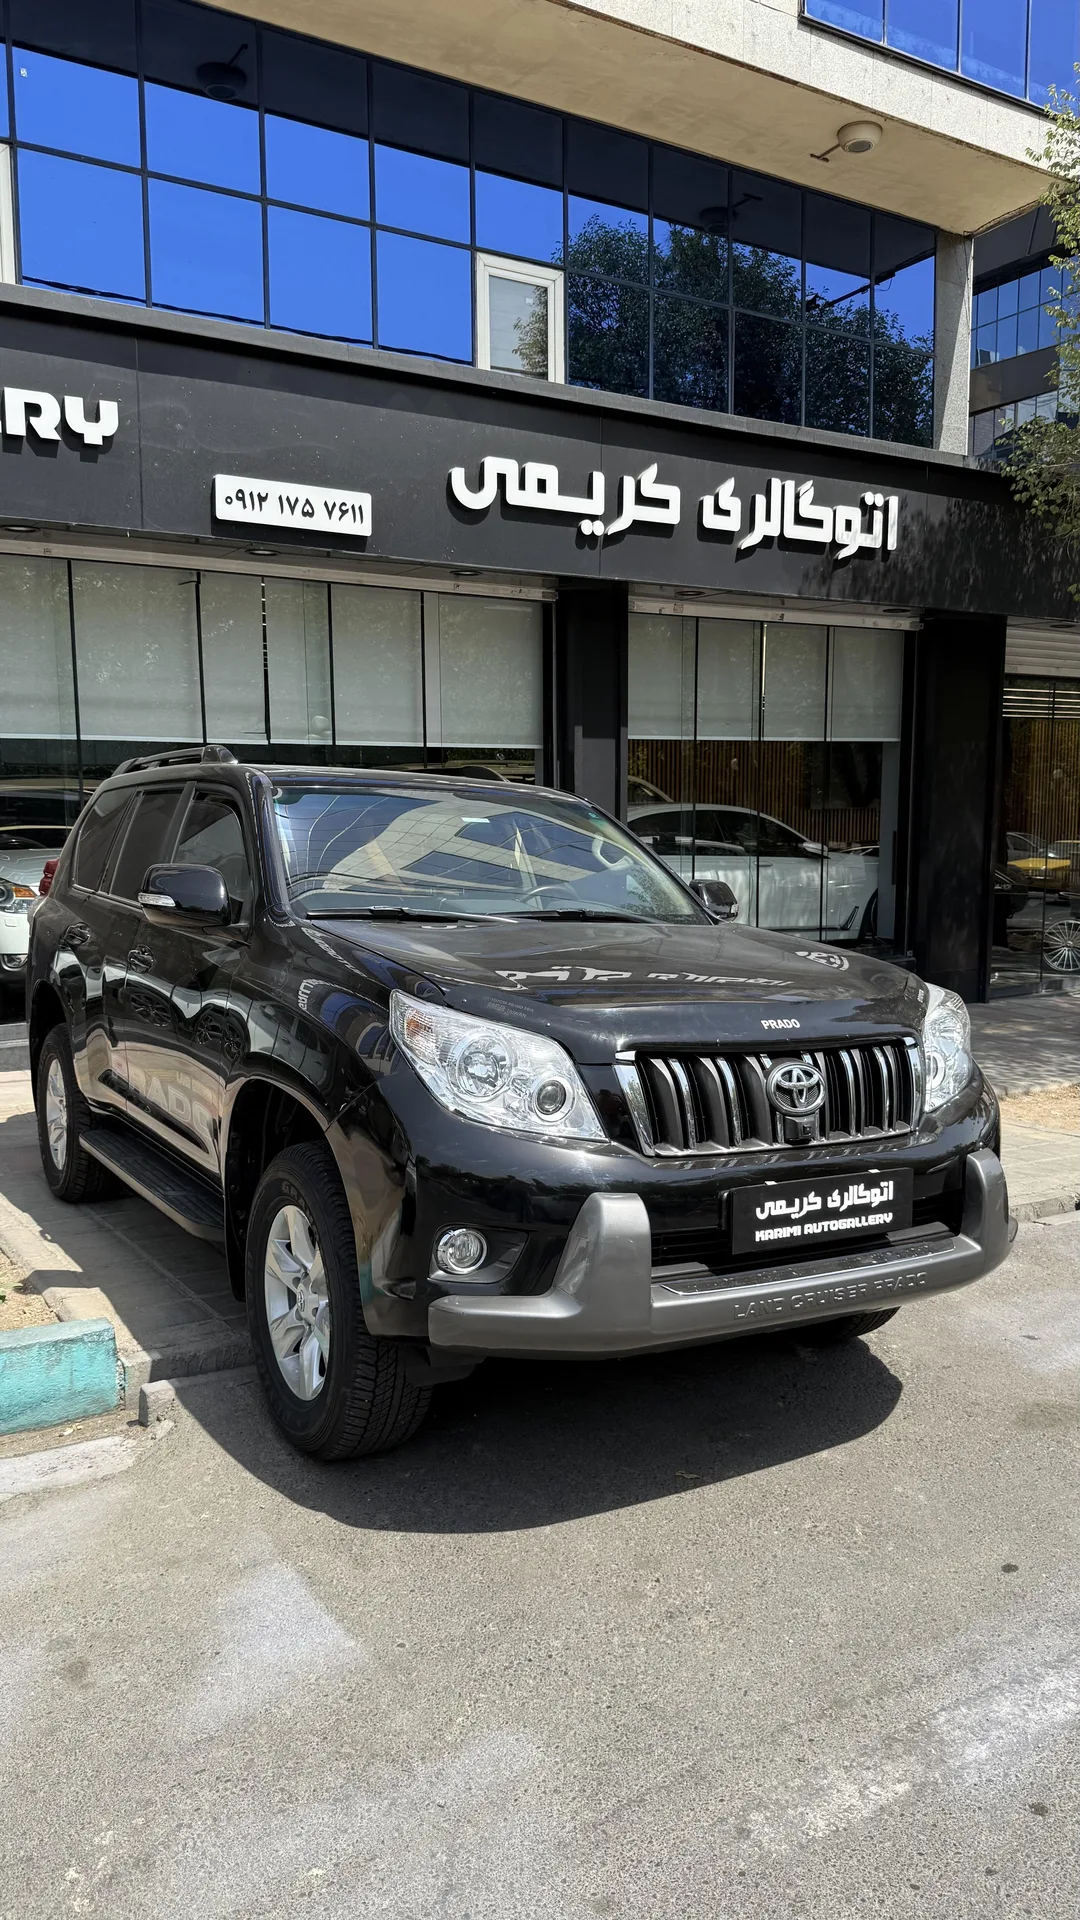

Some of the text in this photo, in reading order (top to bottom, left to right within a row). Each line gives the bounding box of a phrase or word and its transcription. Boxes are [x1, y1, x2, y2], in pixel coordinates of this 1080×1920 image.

[0, 387, 119, 446] RY
[225, 488, 364, 524] ۰۹۱۲ ۱۷۵ ۷۶۱۱
[450, 456, 898, 560] اتوگالری کریمی
[760, 1018, 801, 1030] PRADO
[755, 1180, 894, 1220] اتوگالری کریمی
[755, 1212, 893, 1242] KARIMI AUTOGALLERY
[733, 1271, 928, 1320] LAND CRUISER PRADO
